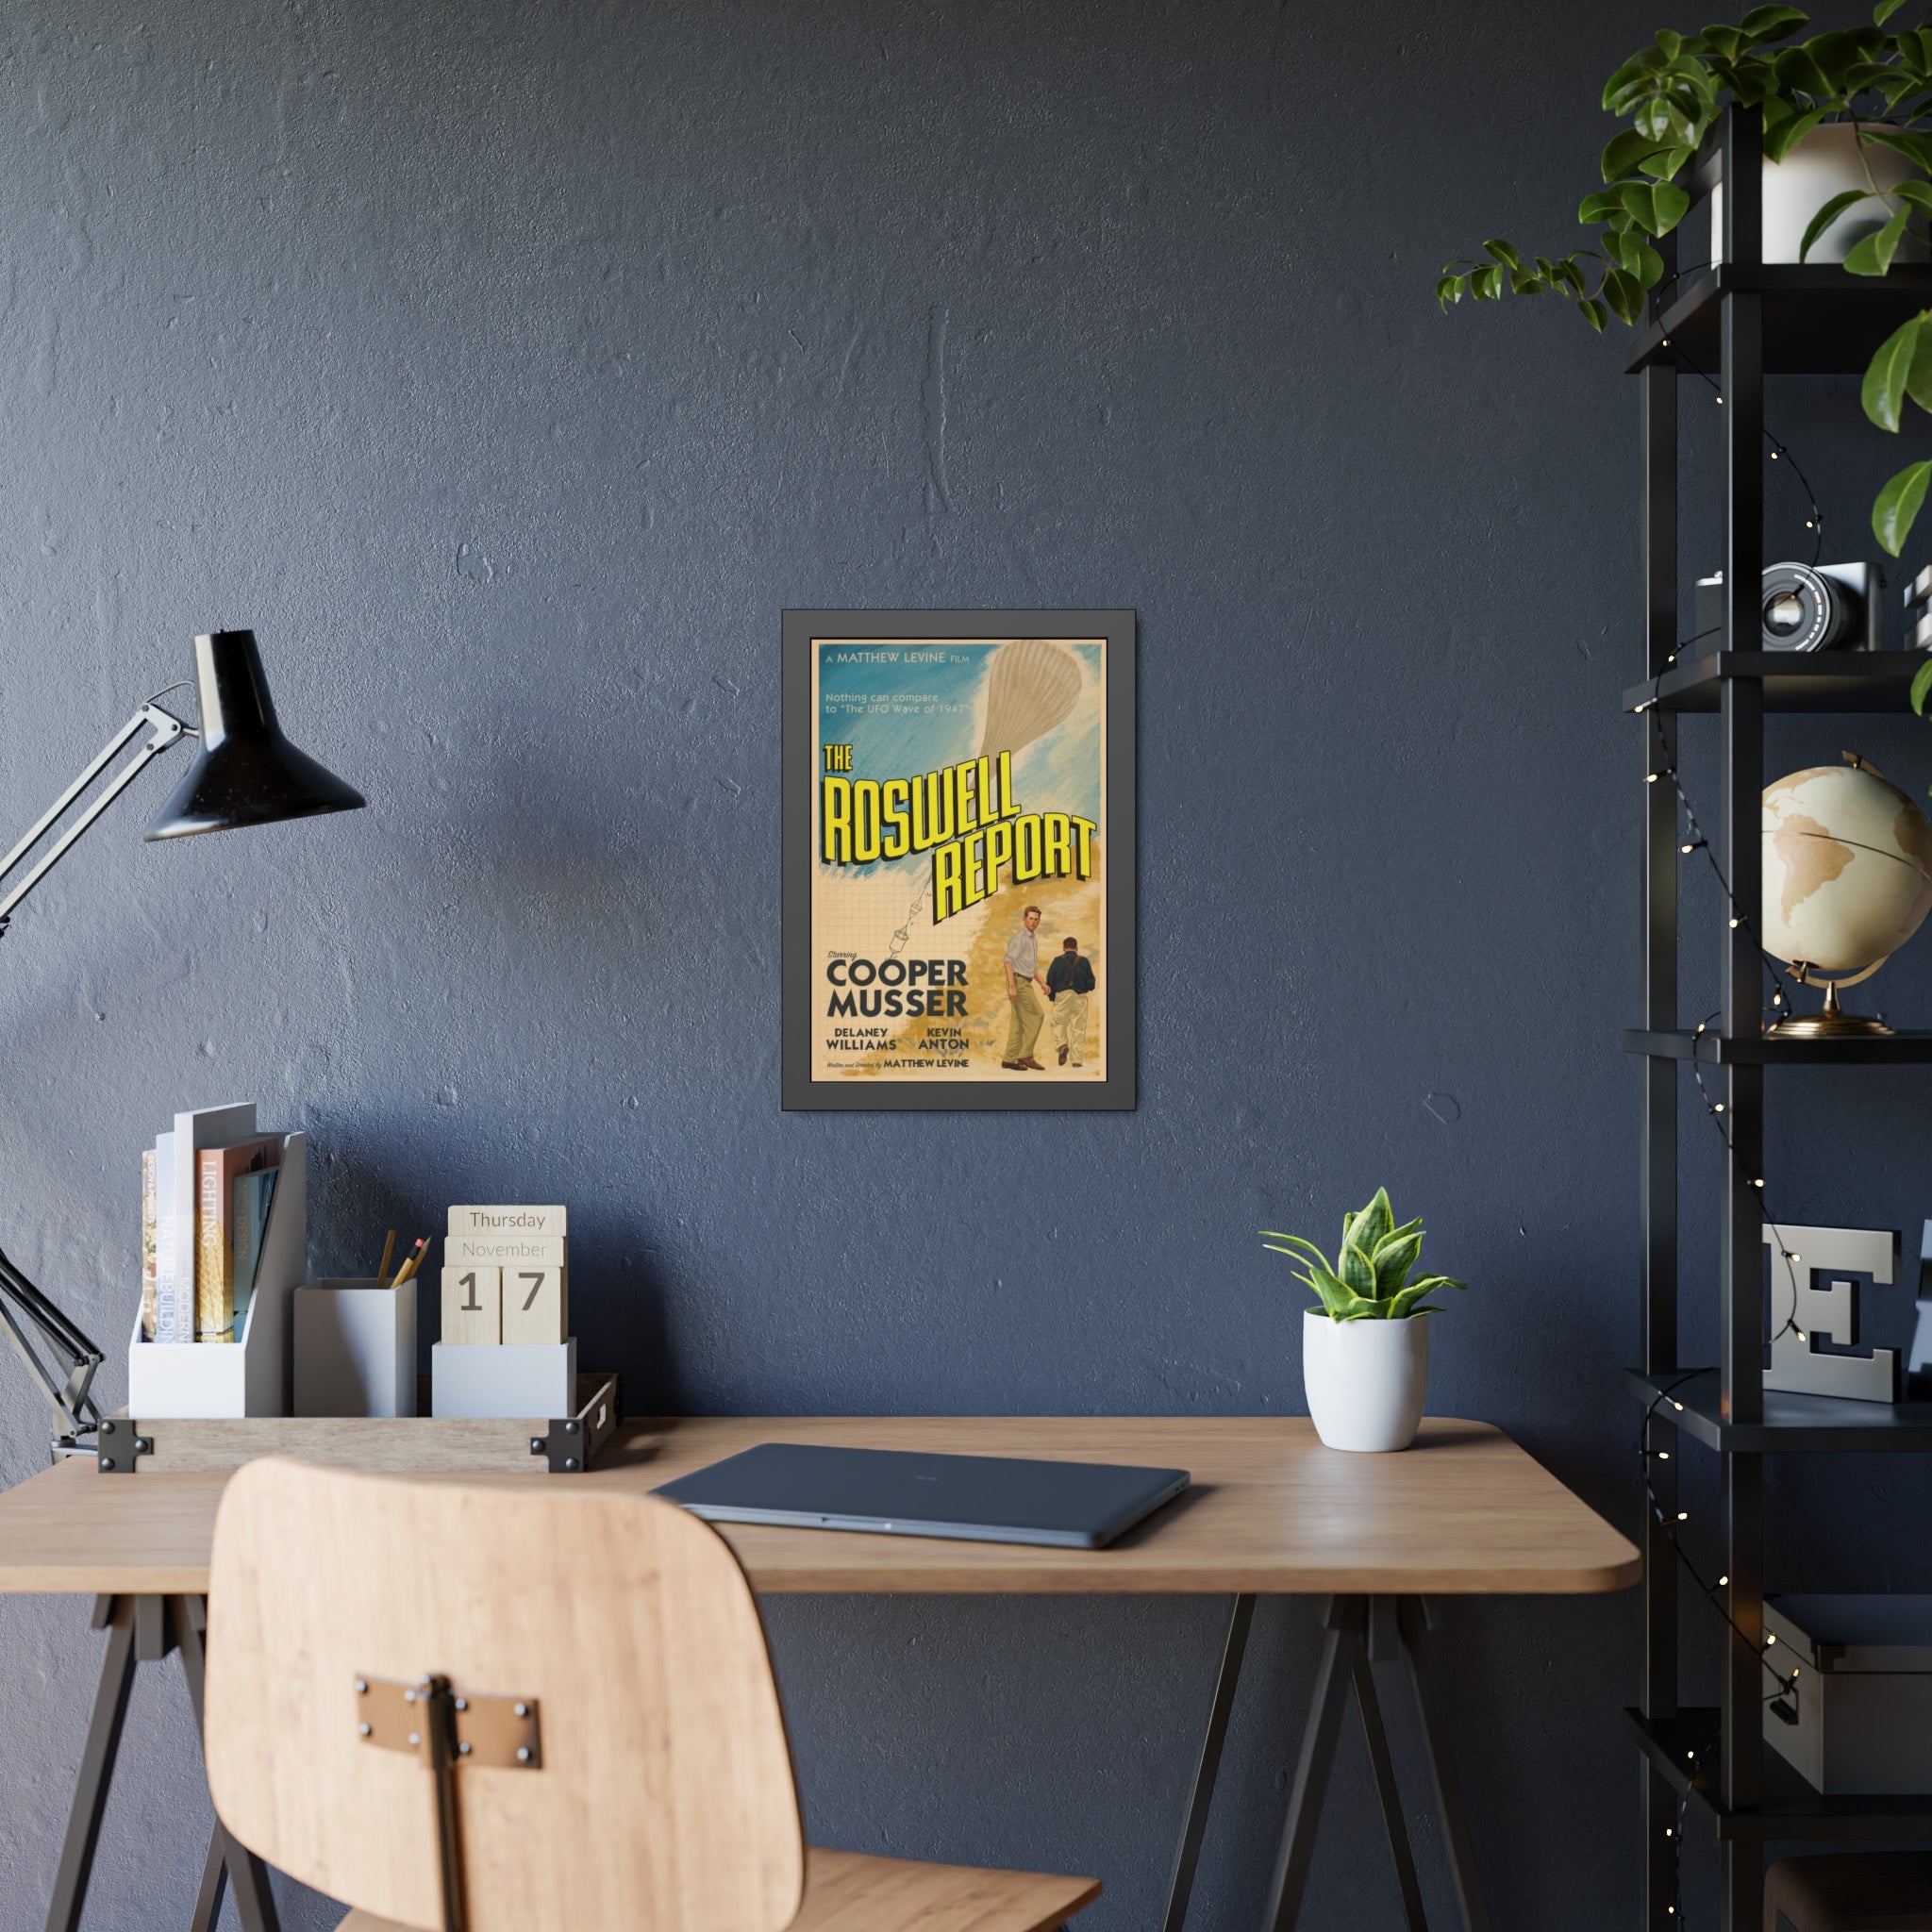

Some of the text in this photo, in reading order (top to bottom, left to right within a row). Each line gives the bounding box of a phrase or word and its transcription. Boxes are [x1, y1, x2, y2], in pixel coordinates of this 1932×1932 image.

[837, 652, 900, 664] MATTHEW
[904, 652, 946, 664] LEVINE
[950, 655, 970, 663] FILM
[825, 693, 867, 704] Nothing
[892, 694, 939, 704] compare
[825, 705, 838, 714] to
[868, 704, 890, 714] UFO
[892, 704, 920, 714] Wave
[924, 704, 935, 714] of
[823, 743, 854, 773] THE
[821, 750, 1022, 867] ROSWELL
[933, 812, 1097, 926] REPORT
[827, 950, 858, 961] Starring
[826, 958, 970, 987] COOPER
[826, 989, 970, 1018] MUSSER
[834, 1027, 889, 1038] DELANEY
[926, 1027, 962, 1038] KEVIN
[825, 1039, 897, 1051] WILLIAMS
[918, 1039, 970, 1050] ANTON
[883, 1059, 934, 1068] MATTHEW
[936, 1058, 970, 1068] LEVINE
[201, 1160, 218, 1248] LIGHTING
[470, 1212, 545, 1230] Thursday
[237, 1217, 247, 1259] DESIGN
[462, 1241, 547, 1257] November
[177, 1276, 192, 1342] MODERN
